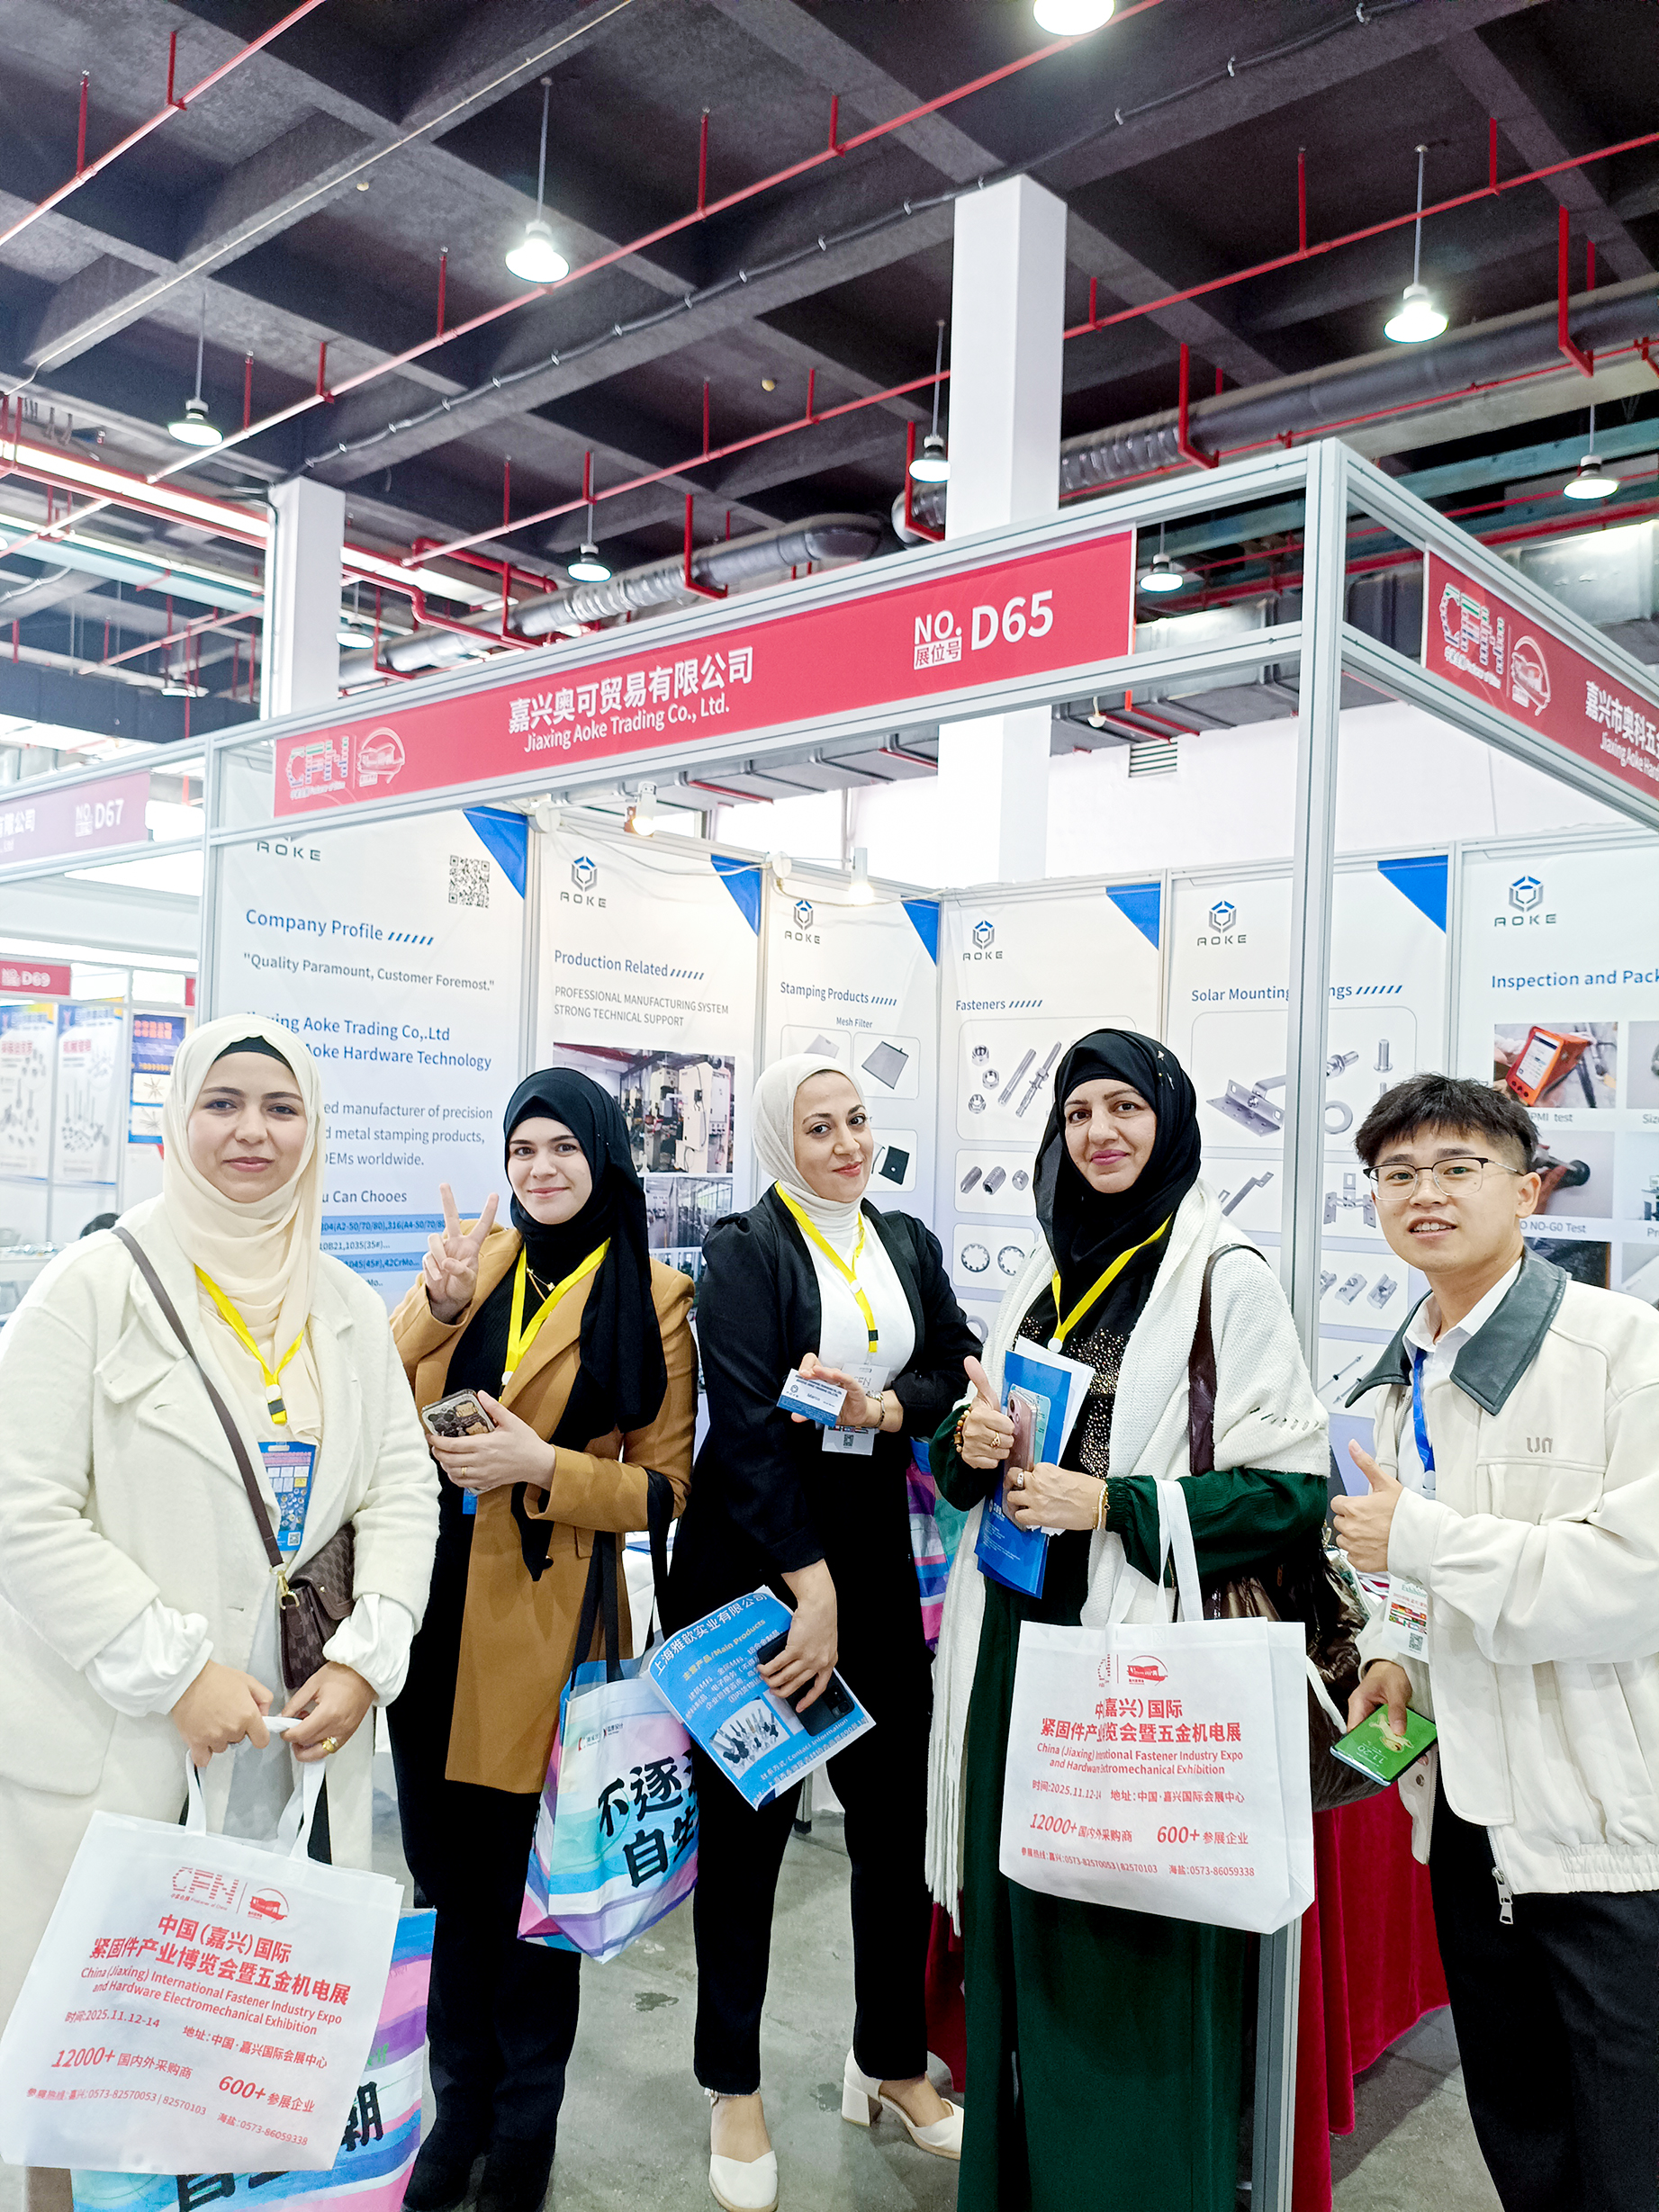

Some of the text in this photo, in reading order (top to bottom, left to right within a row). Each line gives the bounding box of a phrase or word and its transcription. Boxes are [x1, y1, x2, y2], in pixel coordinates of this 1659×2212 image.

[914, 589, 1054, 651] NO. D65
[914, 640, 962, 668] 展位号
[509, 646, 753, 734] 嘉兴奥可贸易有限公司
[524, 692, 730, 752] Jiaxing Aoke Trading Co., Ltd.
[1585, 679, 1659, 759] 嘉兴市奥科五
[95, 798, 124, 830] D67
[257, 841, 321, 861] AOKE
[560, 891, 607, 909] AOKE
[246, 909, 383, 941] Company Profile
[1494, 913, 1557, 927] AOKE
[785, 931, 821, 945] AOKE
[1197, 934, 1247, 946] AOKE
[555, 949, 668, 976] Production Related
[962, 950, 1004, 961] AOKE
[243, 952, 494, 991] "Quality Paramount, Customer Foremost."
[1492, 971, 1580, 990] Inspection
[1584, 970, 1617, 985] and
[555, 985, 729, 1014] PROFESSIONAL MANUFACTURING SYSTEM
[780, 981, 869, 1003] Stamping Products
[1191, 986, 1290, 1002] Solar Mounting
[555, 1004, 684, 1027] STRONG TECHNICAL SUPPORT
[955, 1000, 1005, 1011] Fasteners
[303, 1017, 340, 1033] Aoke
[344, 1020, 399, 1040] Trading
[836, 1017, 872, 1029] Mesh Filter
[344, 1046, 413, 1064] Hardware
[417, 1050, 491, 1072] Technology
[342, 1102, 424, 1118] manufacturer
[428, 1105, 441, 1119] of
[442, 1106, 493, 1125] precision
[1554, 1112, 1573, 1123] test
[335, 1127, 371, 1140] metal
[374, 1128, 429, 1145] stamping
[432, 1129, 485, 1145] products,
[326, 1152, 424, 1165] EMs worldwide.
[333, 1191, 357, 1203] Can
[361, 1190, 408, 1203] Chooes
[1566, 1222, 1586, 1234] Test
[655, 1593, 768, 1676] 上海雅歆实业有限公司
[733, 1619, 766, 1645] Products
[1037, 1742, 1060, 1755] China
[1060, 1744, 1095, 1762] (Jiaxing)
[1136, 1749, 1178, 1761] Fastener
[1180, 1750, 1217, 1763] Industry
[1221, 1749, 1243, 1762] Expo
[1050, 1758, 1065, 1768] and
[1177, 1764, 1225, 1775] Exhibition
[598, 1749, 695, 1837] 不逐
[1030, 1813, 1249, 1845] 12000+ 国内外采购商 600+ 参展企业
[158, 1913, 292, 1964] 中国（嘉兴）国际
[89, 1935, 351, 2006] 紧固件产业博览会暨五金机电展
[81, 1965, 343, 2025] China (Jiaxing) International Fastener Industry Expo
[93, 1980, 318, 2036] and Hardware Electromechanical Exhibition
[51, 2046, 315, 2113] 12000+ 国内外采购商 600+ 参展企业
[162, 2096, 206, 2116] 82570103
